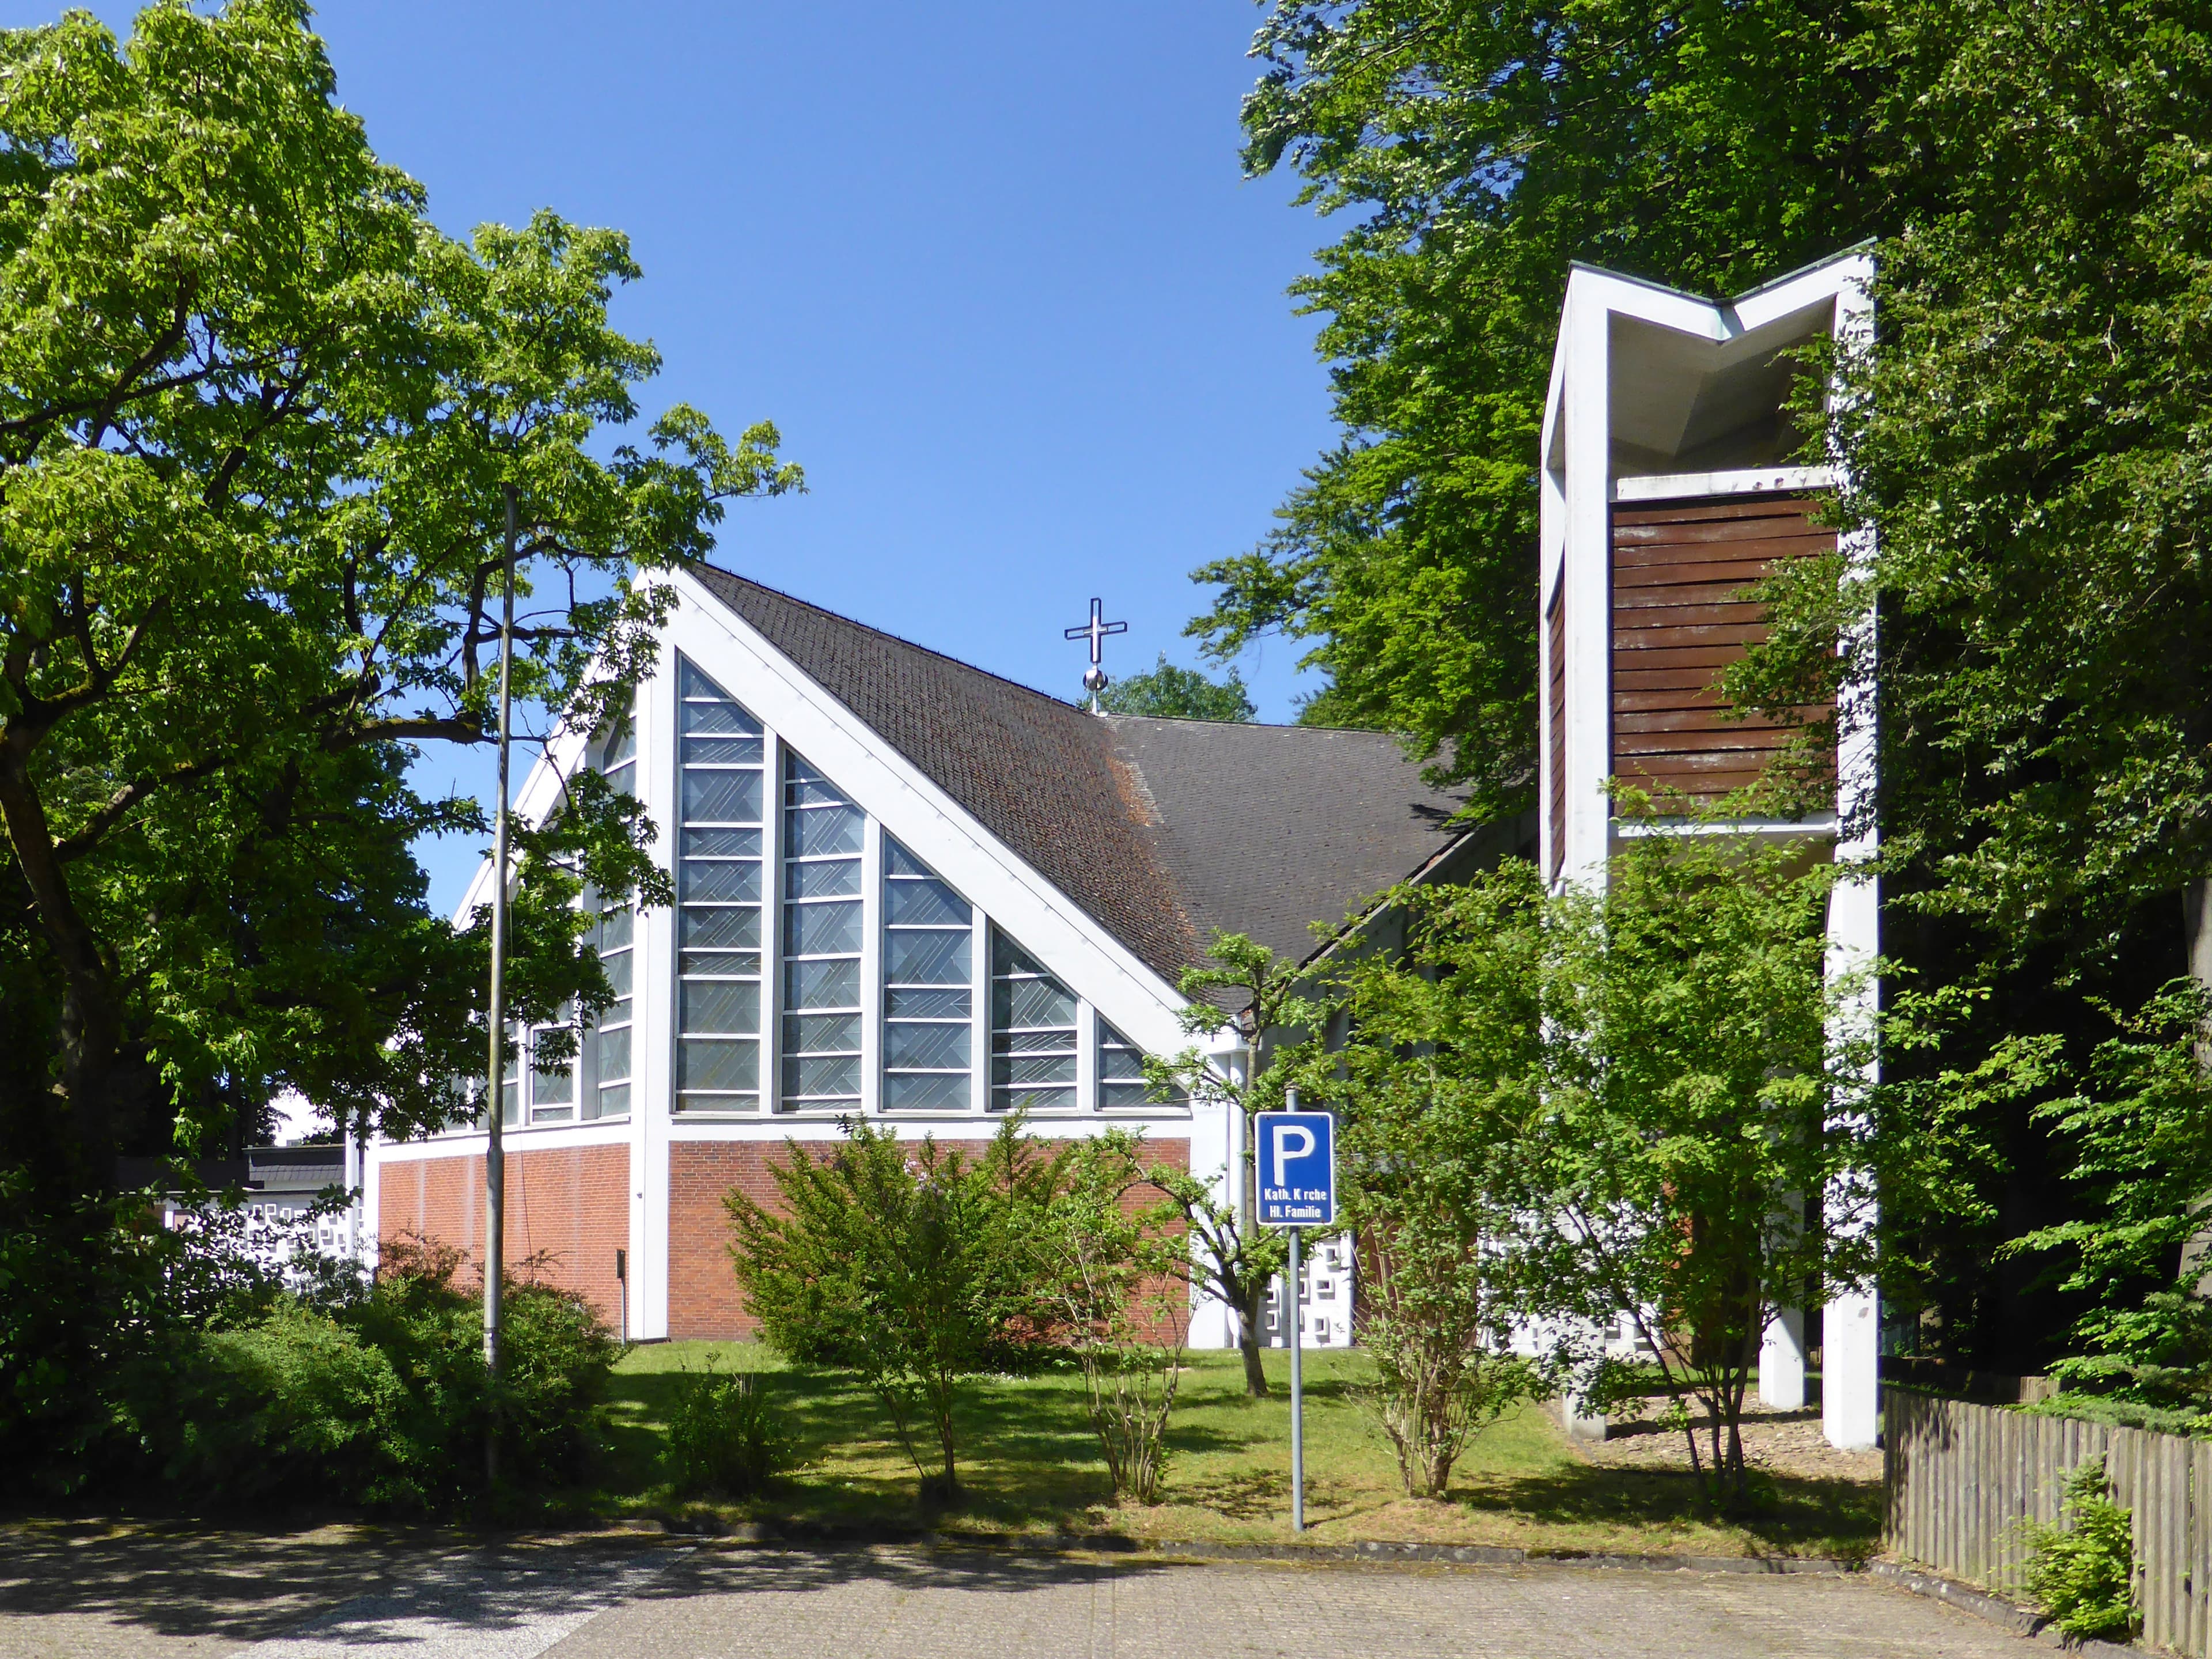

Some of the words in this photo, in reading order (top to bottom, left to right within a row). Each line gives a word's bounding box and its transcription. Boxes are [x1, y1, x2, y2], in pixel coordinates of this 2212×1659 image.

[1273, 1126, 1315, 1186] P
[1264, 1188, 1291, 1200] Kath.
[1293, 1188, 1327, 1200] Krche
[1269, 1205, 1283, 1218] Hl.
[1285, 1205, 1321, 1218] Familie
